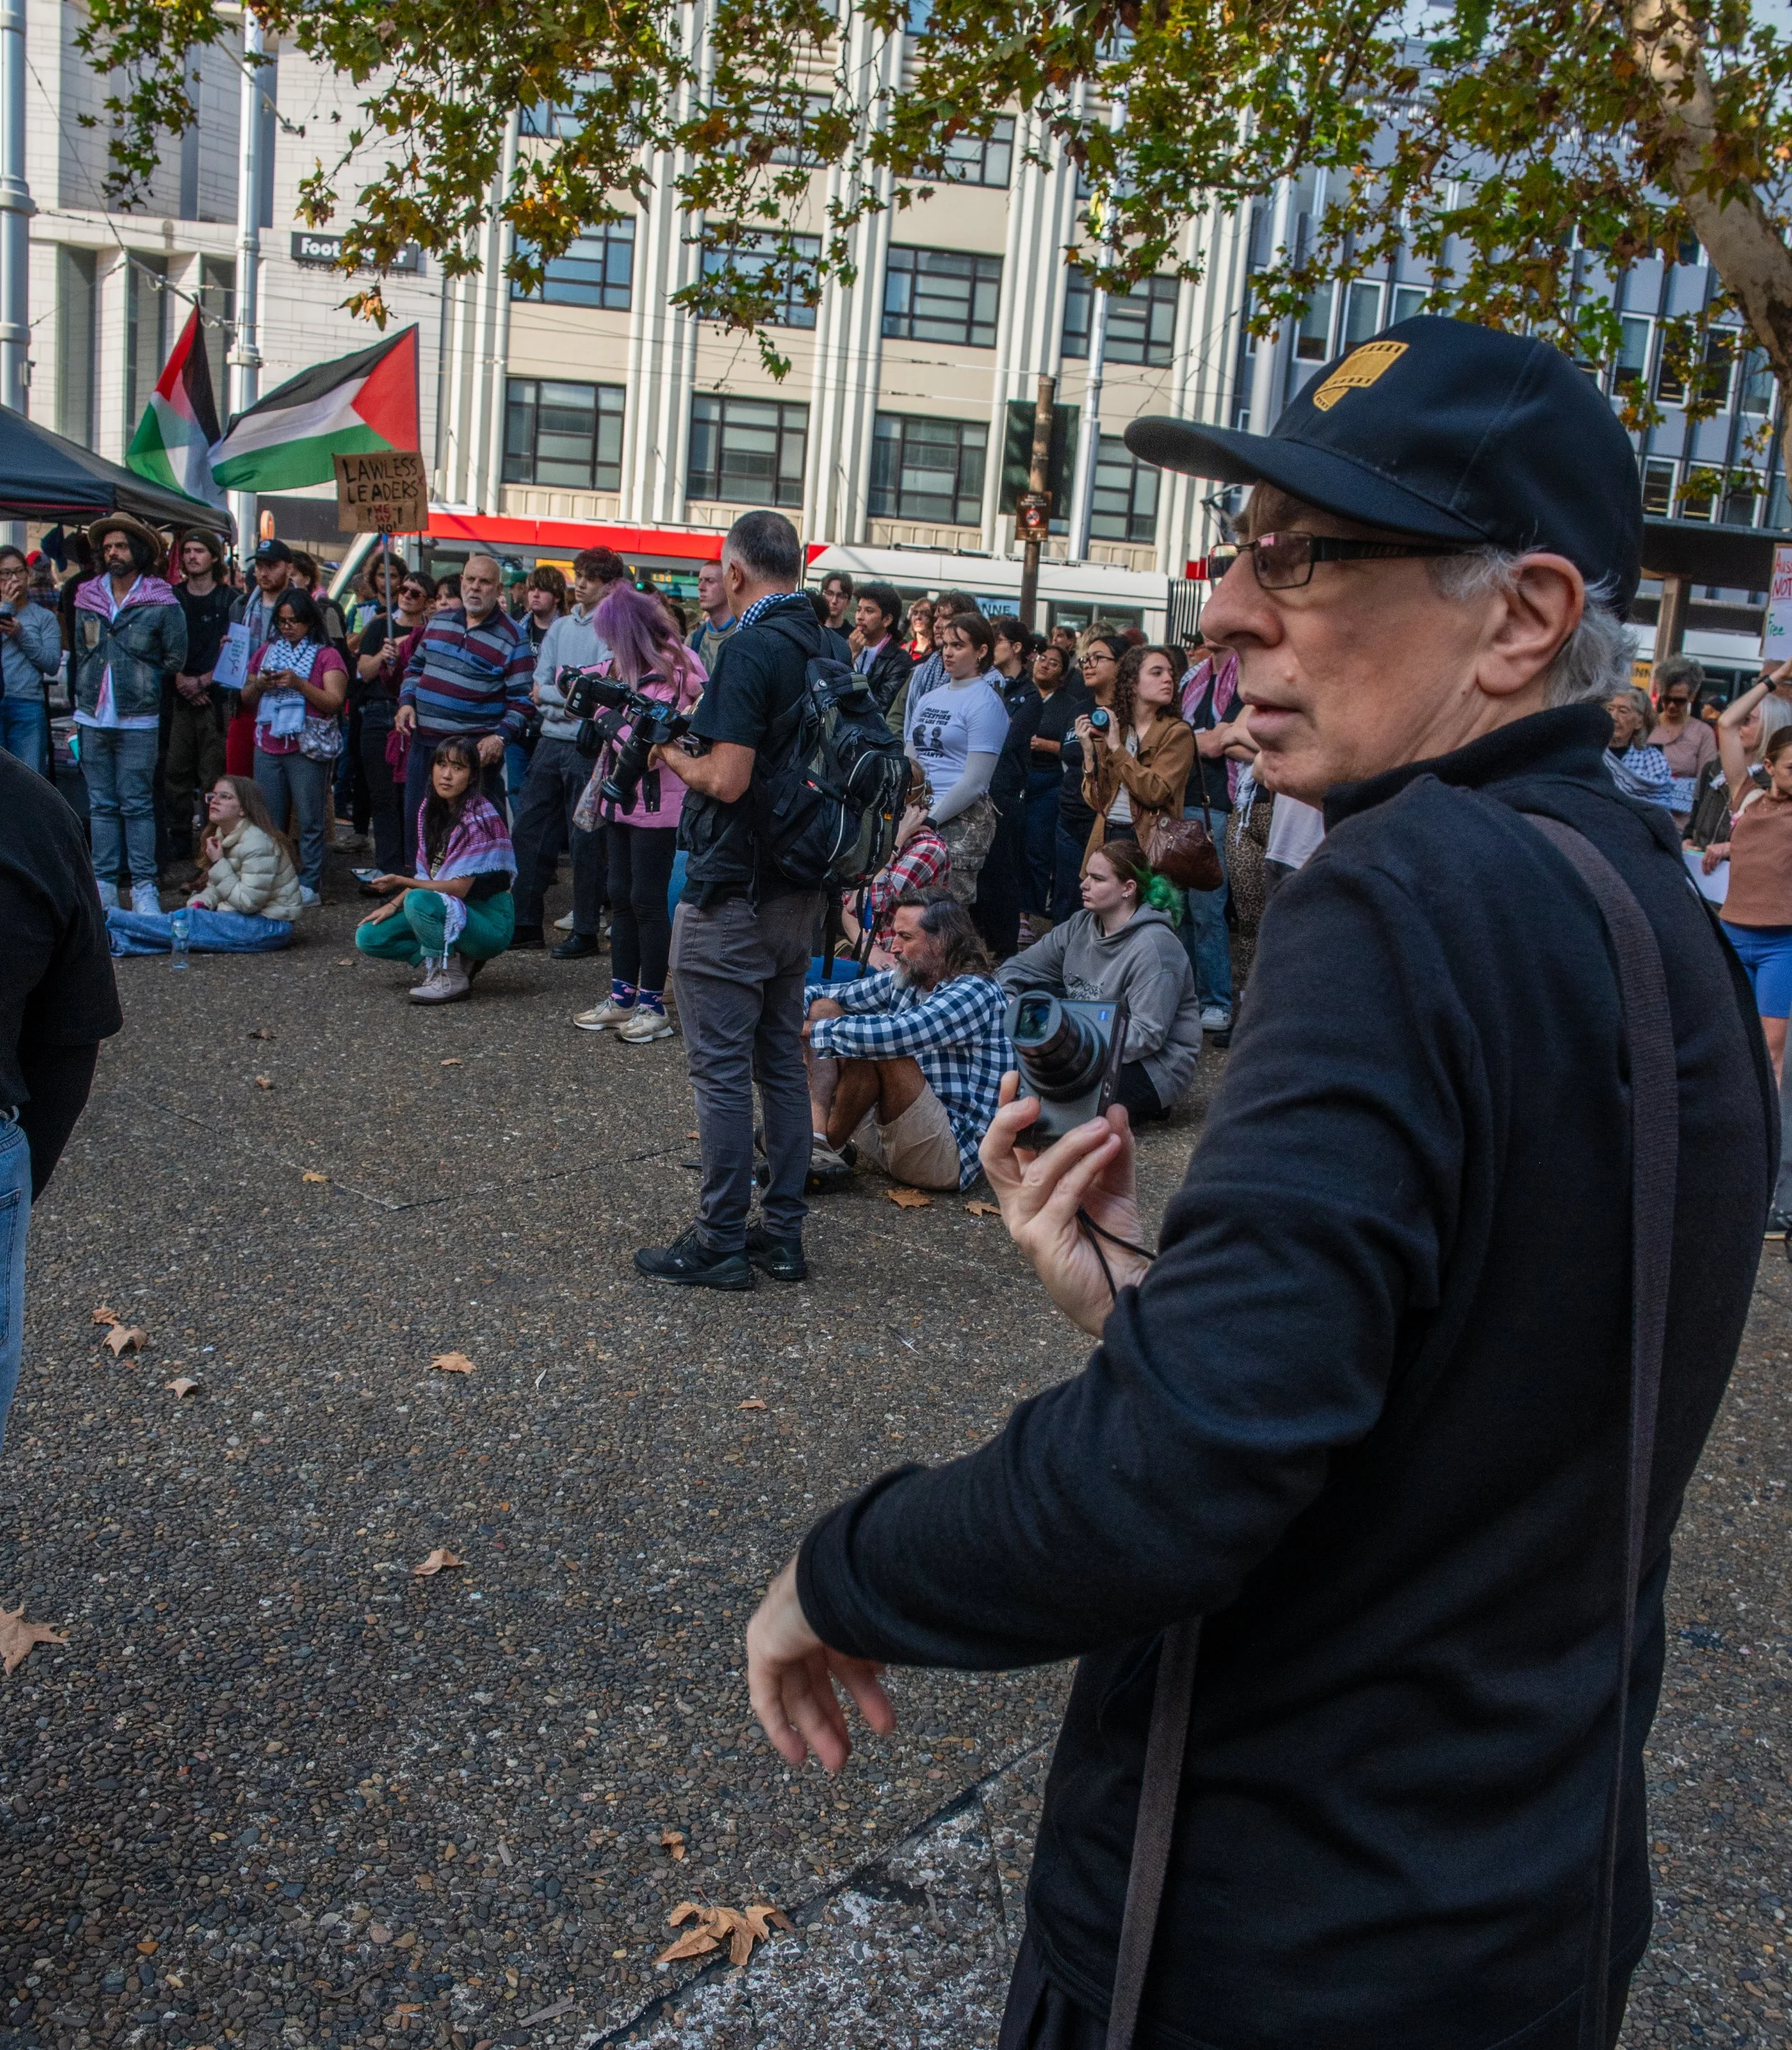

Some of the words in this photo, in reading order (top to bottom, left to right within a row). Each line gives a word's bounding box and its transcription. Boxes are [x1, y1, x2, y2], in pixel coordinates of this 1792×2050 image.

[301, 237, 341, 257] Foot
[343, 458, 417, 483] LAWLESS
[347, 480, 419, 504] LEADERS
[373, 504, 390, 513] WE
[374, 514, 391, 523] SAY
[1772, 578, 1792, 597] NOT
[1768, 613, 1786, 637] Free
